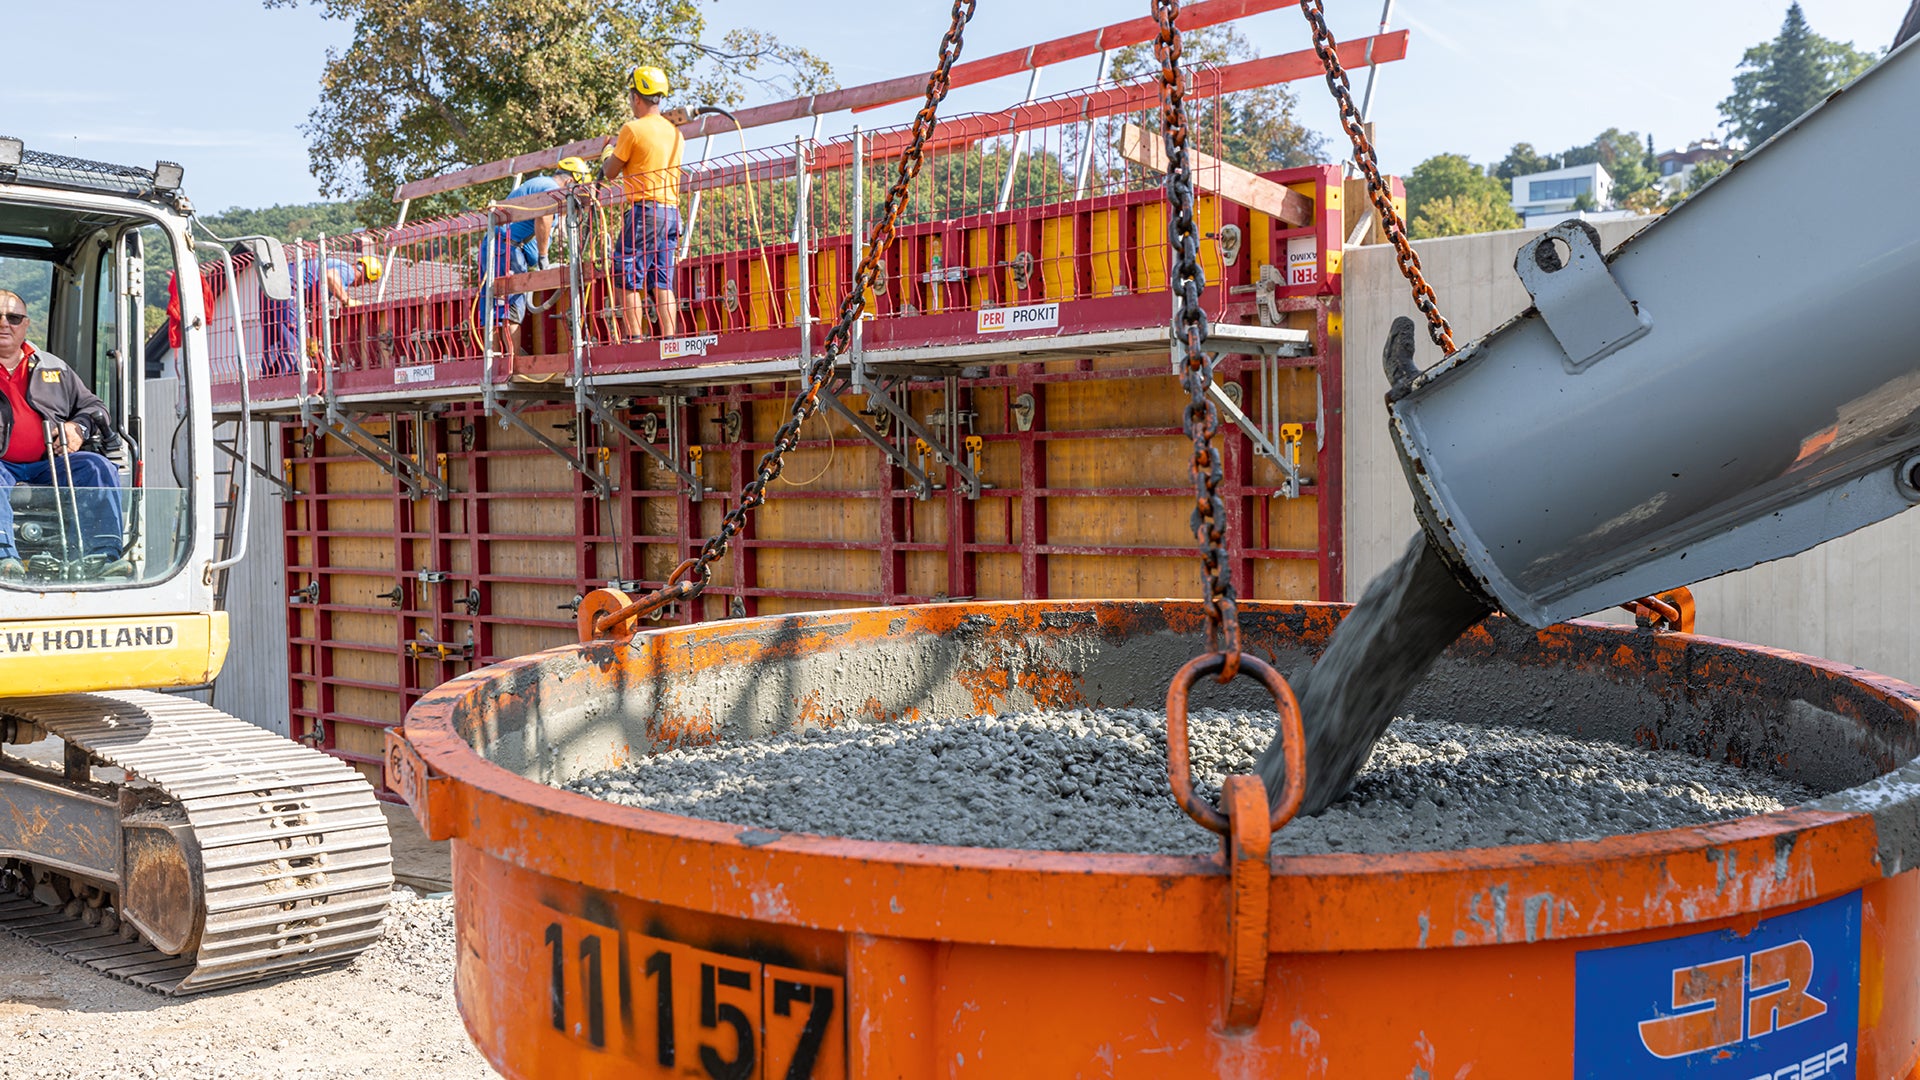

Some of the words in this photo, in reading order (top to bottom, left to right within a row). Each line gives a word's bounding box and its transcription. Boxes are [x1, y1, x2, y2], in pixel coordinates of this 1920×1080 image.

[1290, 252, 1317, 262] AXIMO
[1293, 268, 1318, 284] PERI
[983, 312, 1005, 326] PERI
[1013, 307, 1056, 323] PROKIT
[664, 341, 680, 353] PERI
[42, 369, 61, 383] CAT
[413, 366, 434, 377] PROKIT
[0, 632, 34, 652] W
[43, 626, 174, 651] HOLLAND
